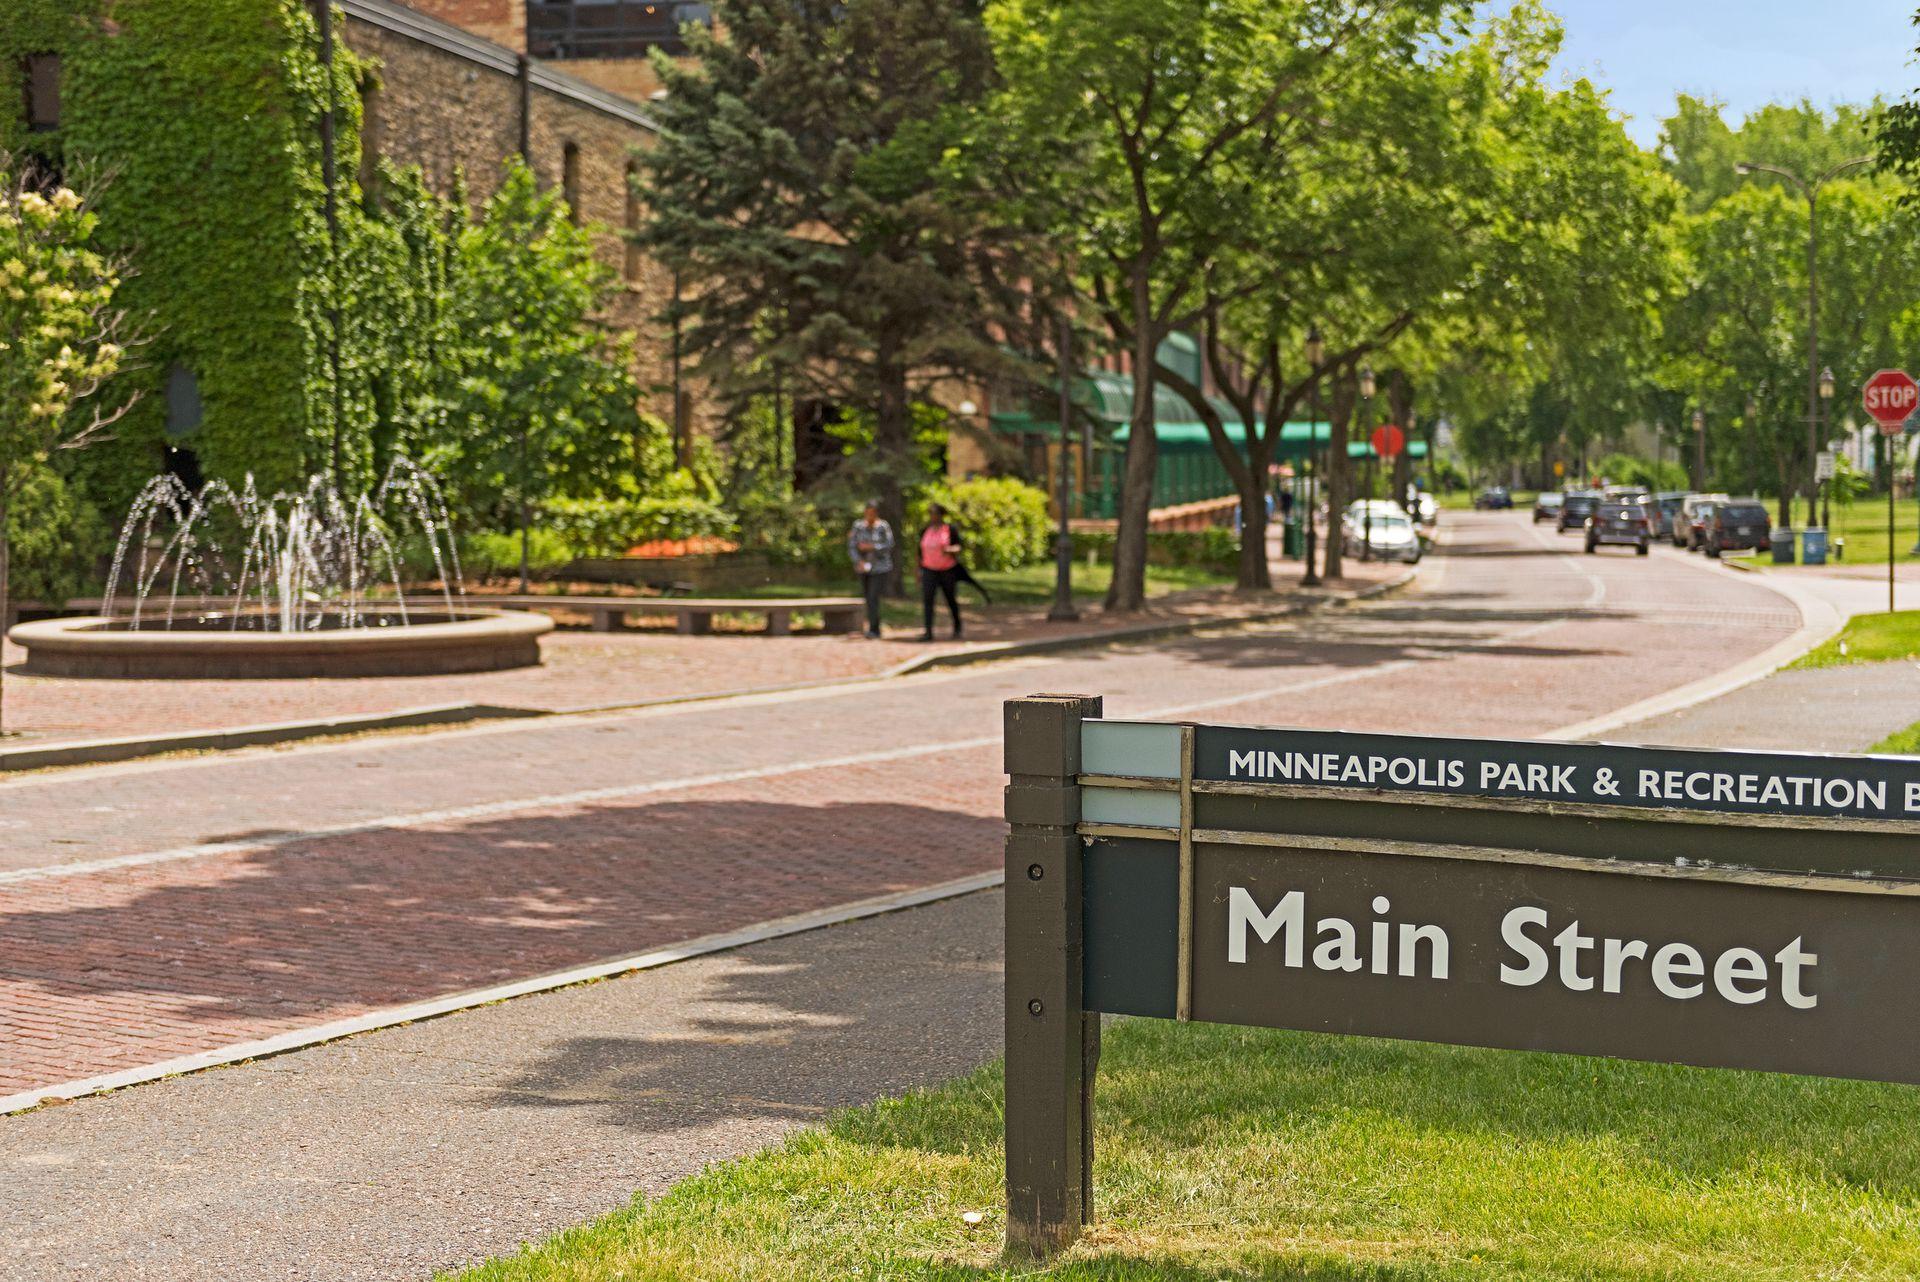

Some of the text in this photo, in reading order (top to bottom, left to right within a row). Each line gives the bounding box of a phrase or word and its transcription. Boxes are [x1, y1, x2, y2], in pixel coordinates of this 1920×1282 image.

[1867, 386, 1915, 409] STOP
[1229, 749, 1465, 788] MINNEAPOLIS
[1480, 761, 1577, 794] PARK
[1592, 767, 1621, 796] &
[1638, 769, 1887, 811] RECREATION
[1228, 886, 1818, 1010] Main Street
